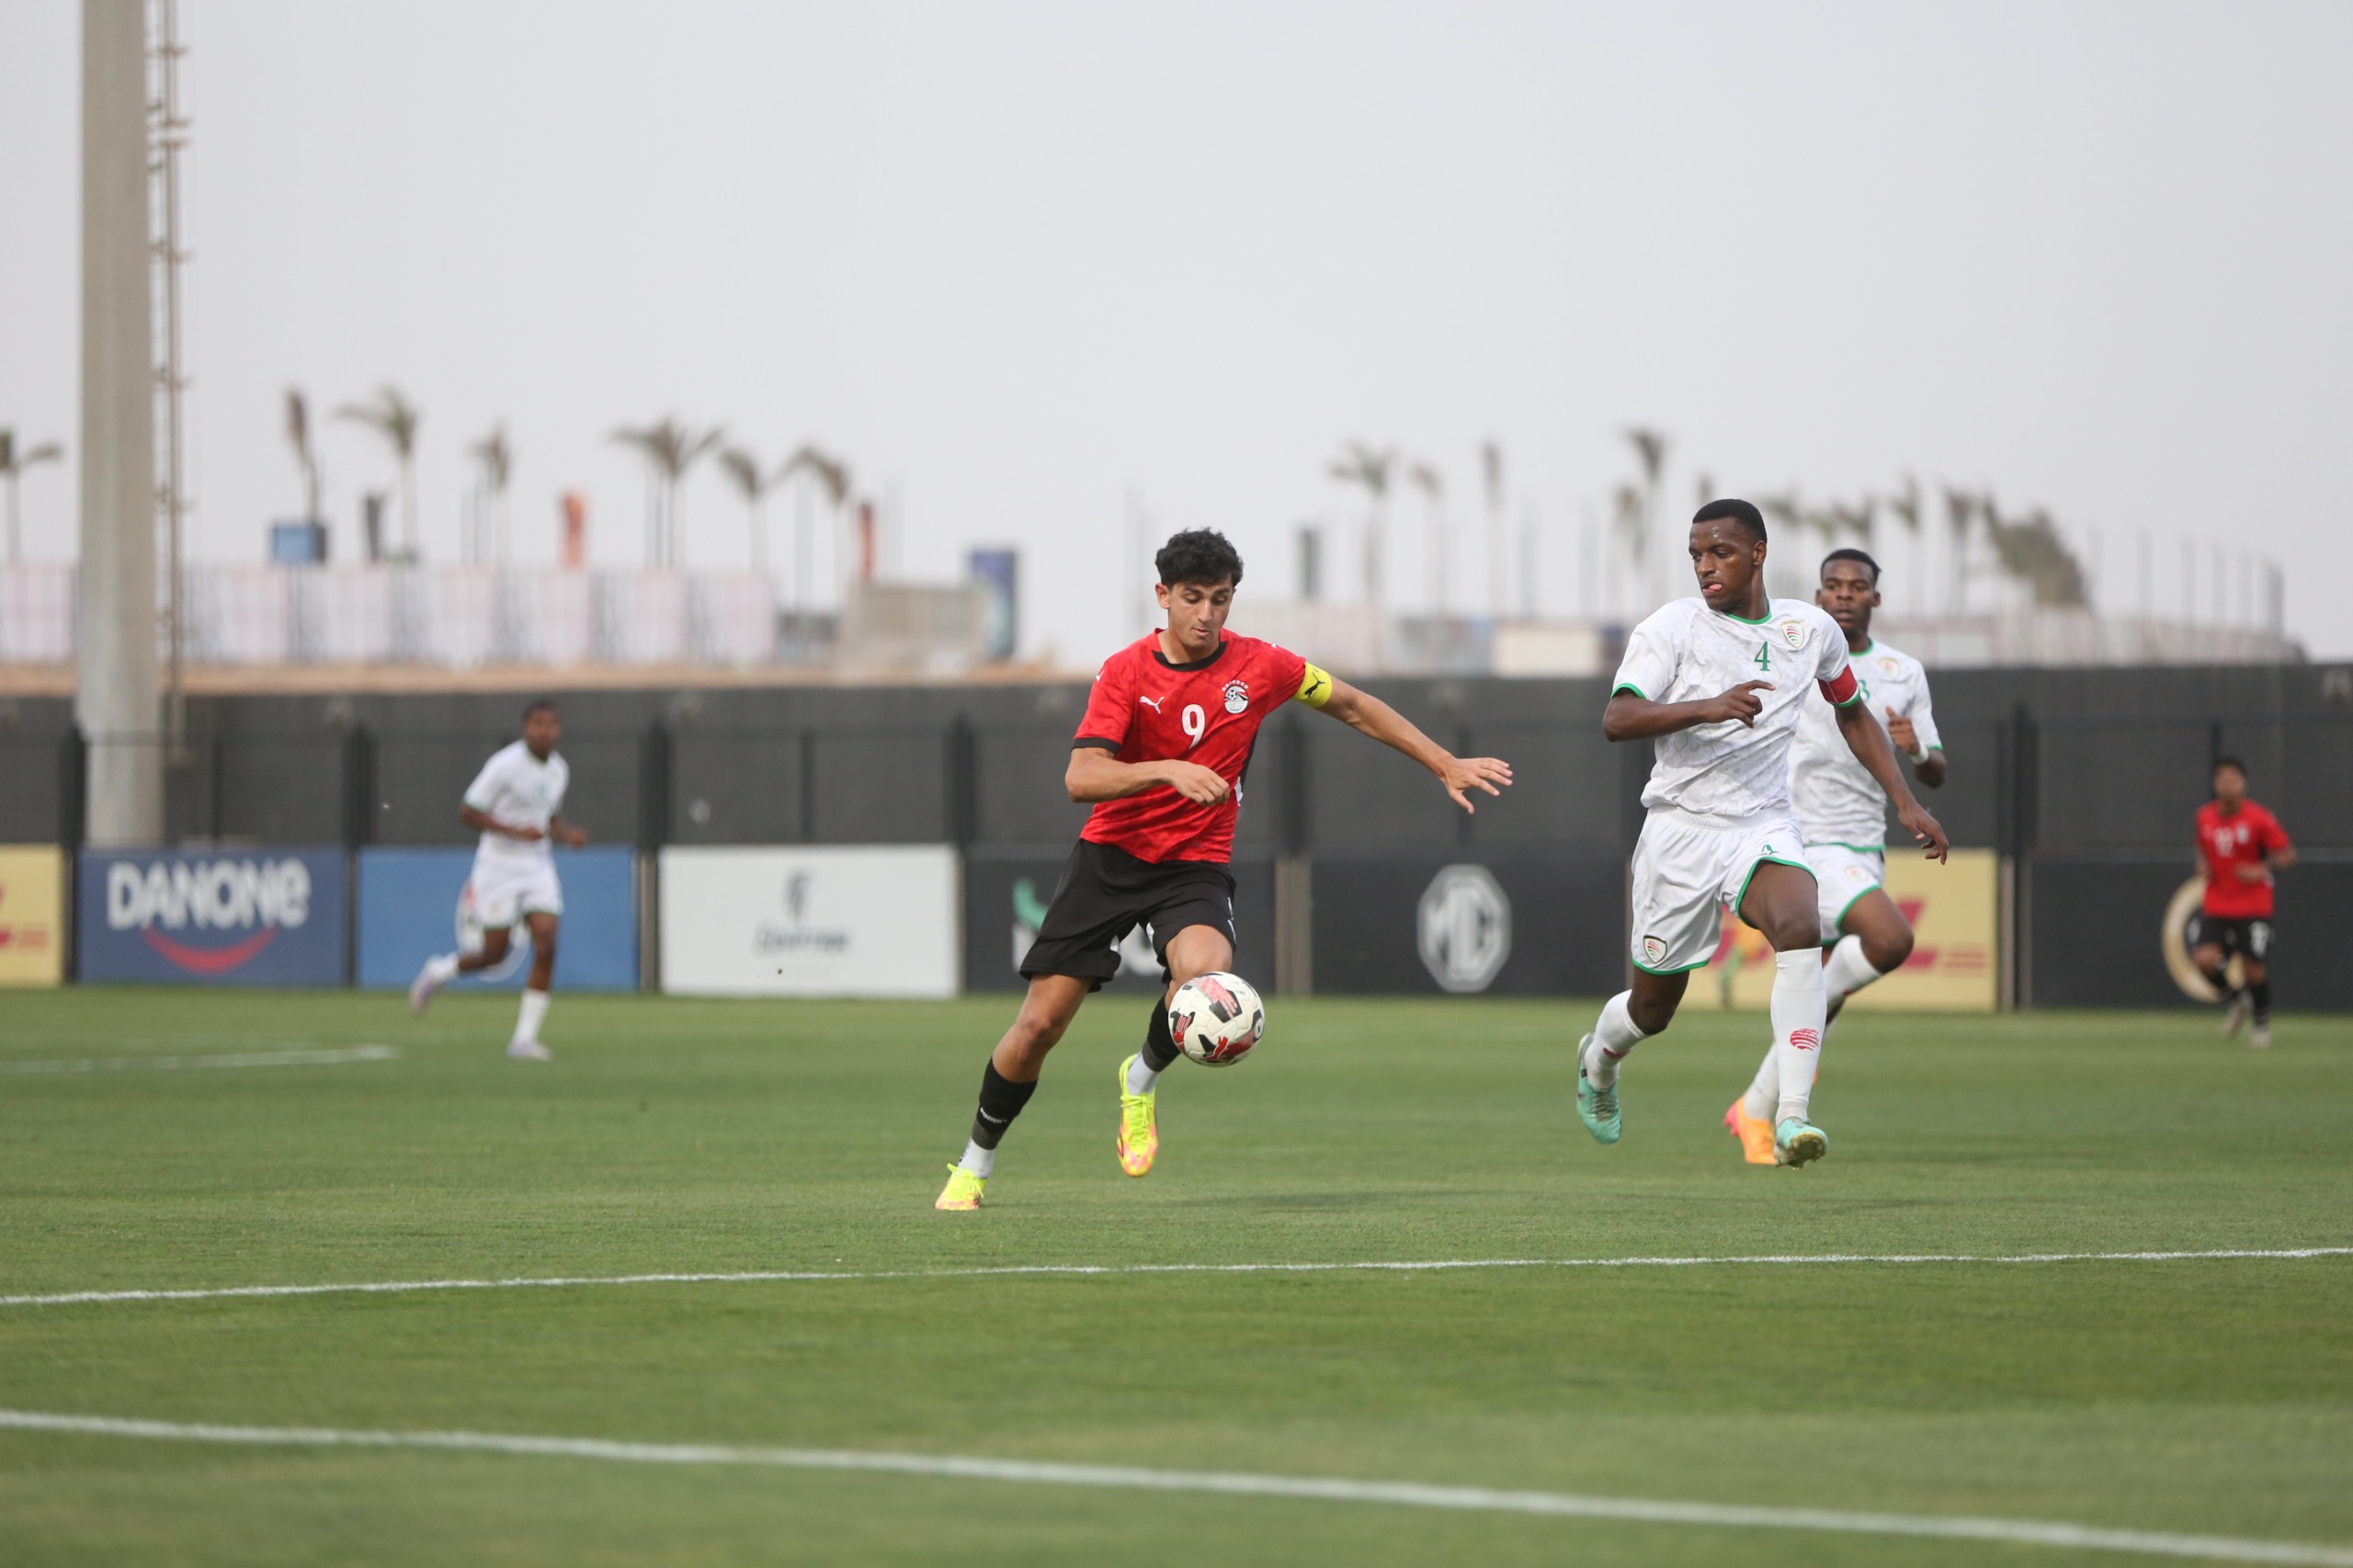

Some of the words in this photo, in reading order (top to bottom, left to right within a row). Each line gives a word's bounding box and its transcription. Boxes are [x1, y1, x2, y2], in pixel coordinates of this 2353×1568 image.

[1754, 641, 1770, 671] 4
[1181, 703, 1206, 750] 9
[1424, 876, 1504, 982] MG
